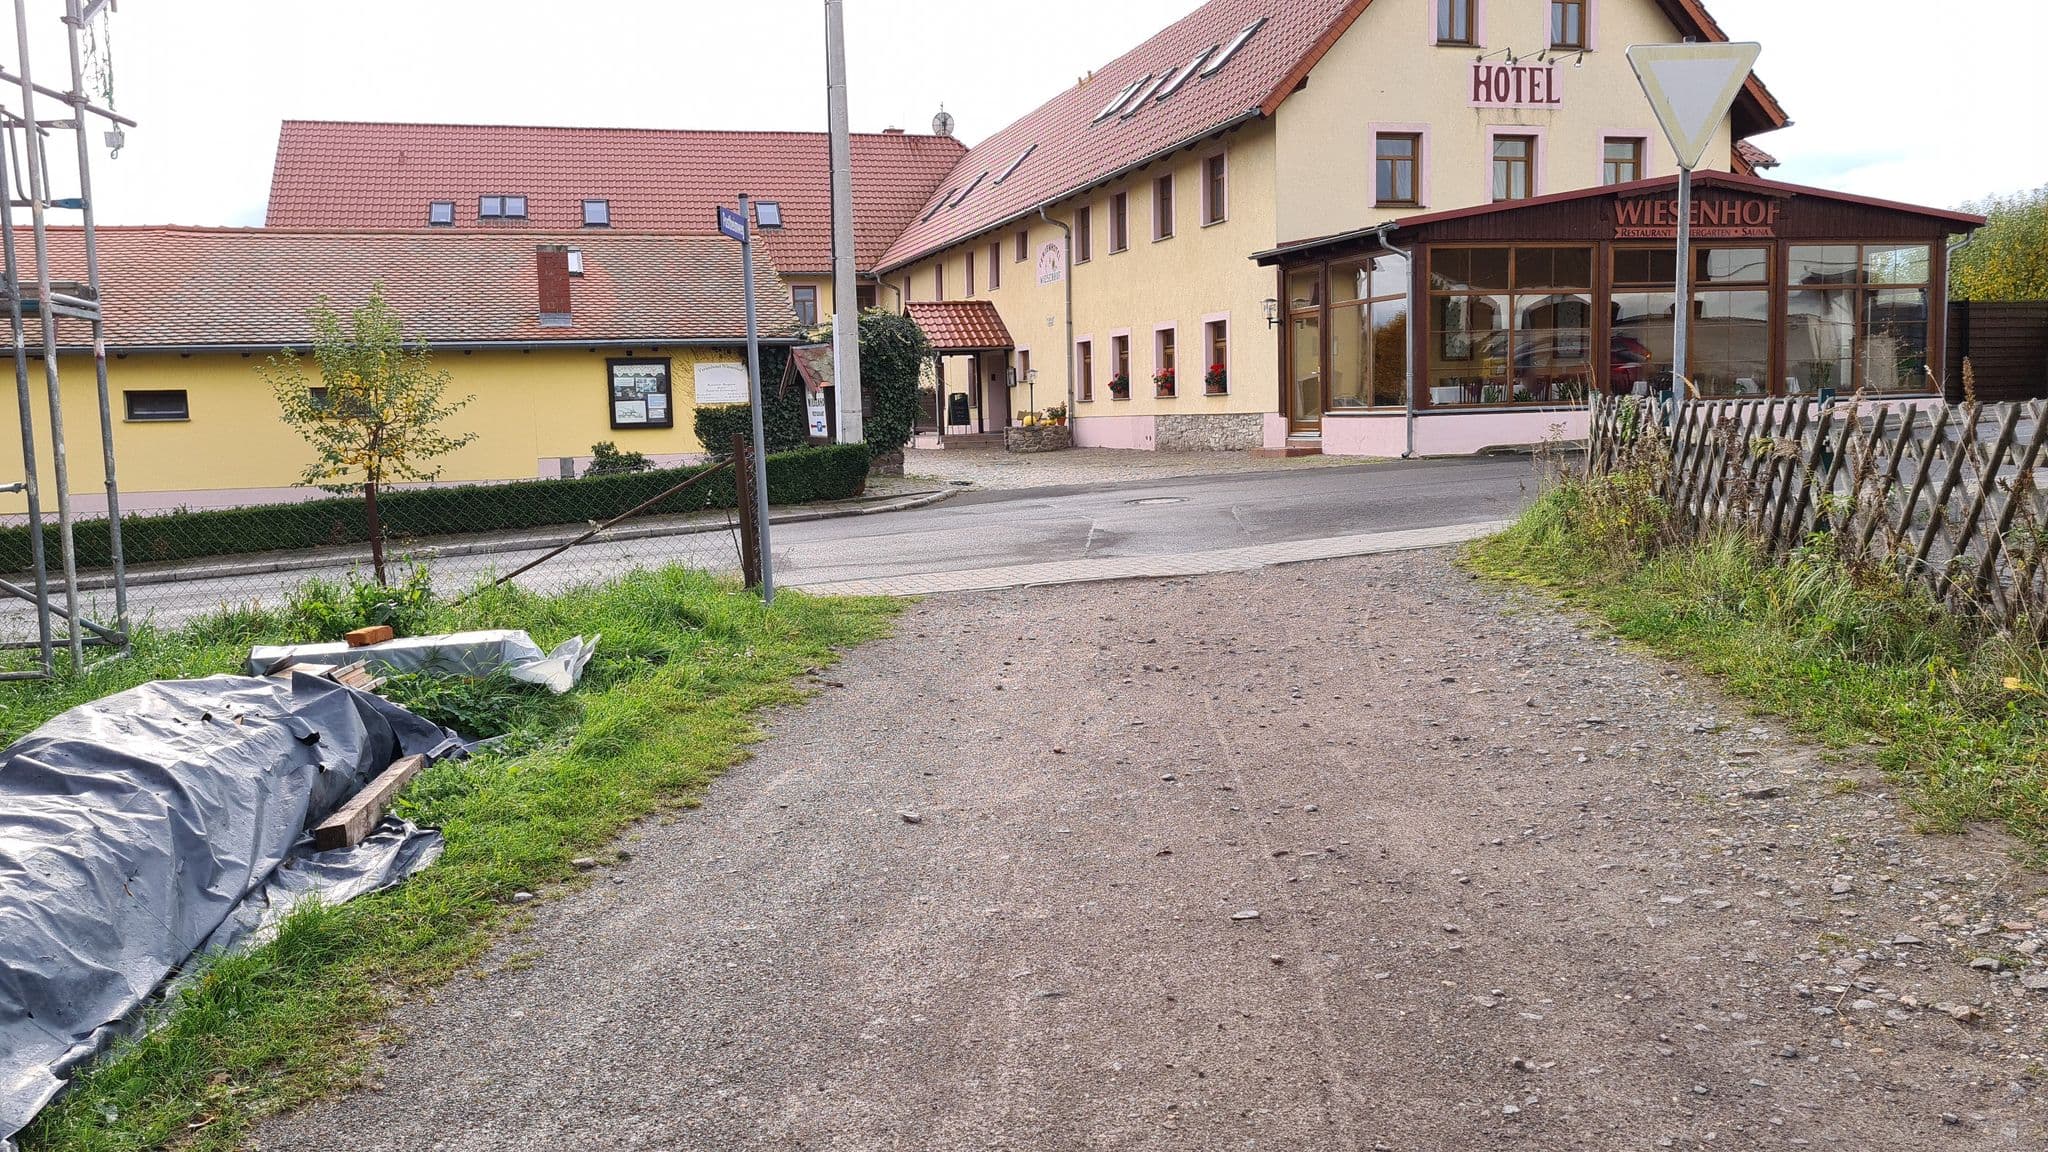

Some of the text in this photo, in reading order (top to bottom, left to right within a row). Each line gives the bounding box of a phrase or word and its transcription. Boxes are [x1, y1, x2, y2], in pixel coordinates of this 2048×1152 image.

[1472, 65, 1561, 104] HOTEL
[1614, 199, 1780, 225] WIESENHOF
[1621, 227, 1769, 237] RESTAURANT IERGARTEN SAUNA
